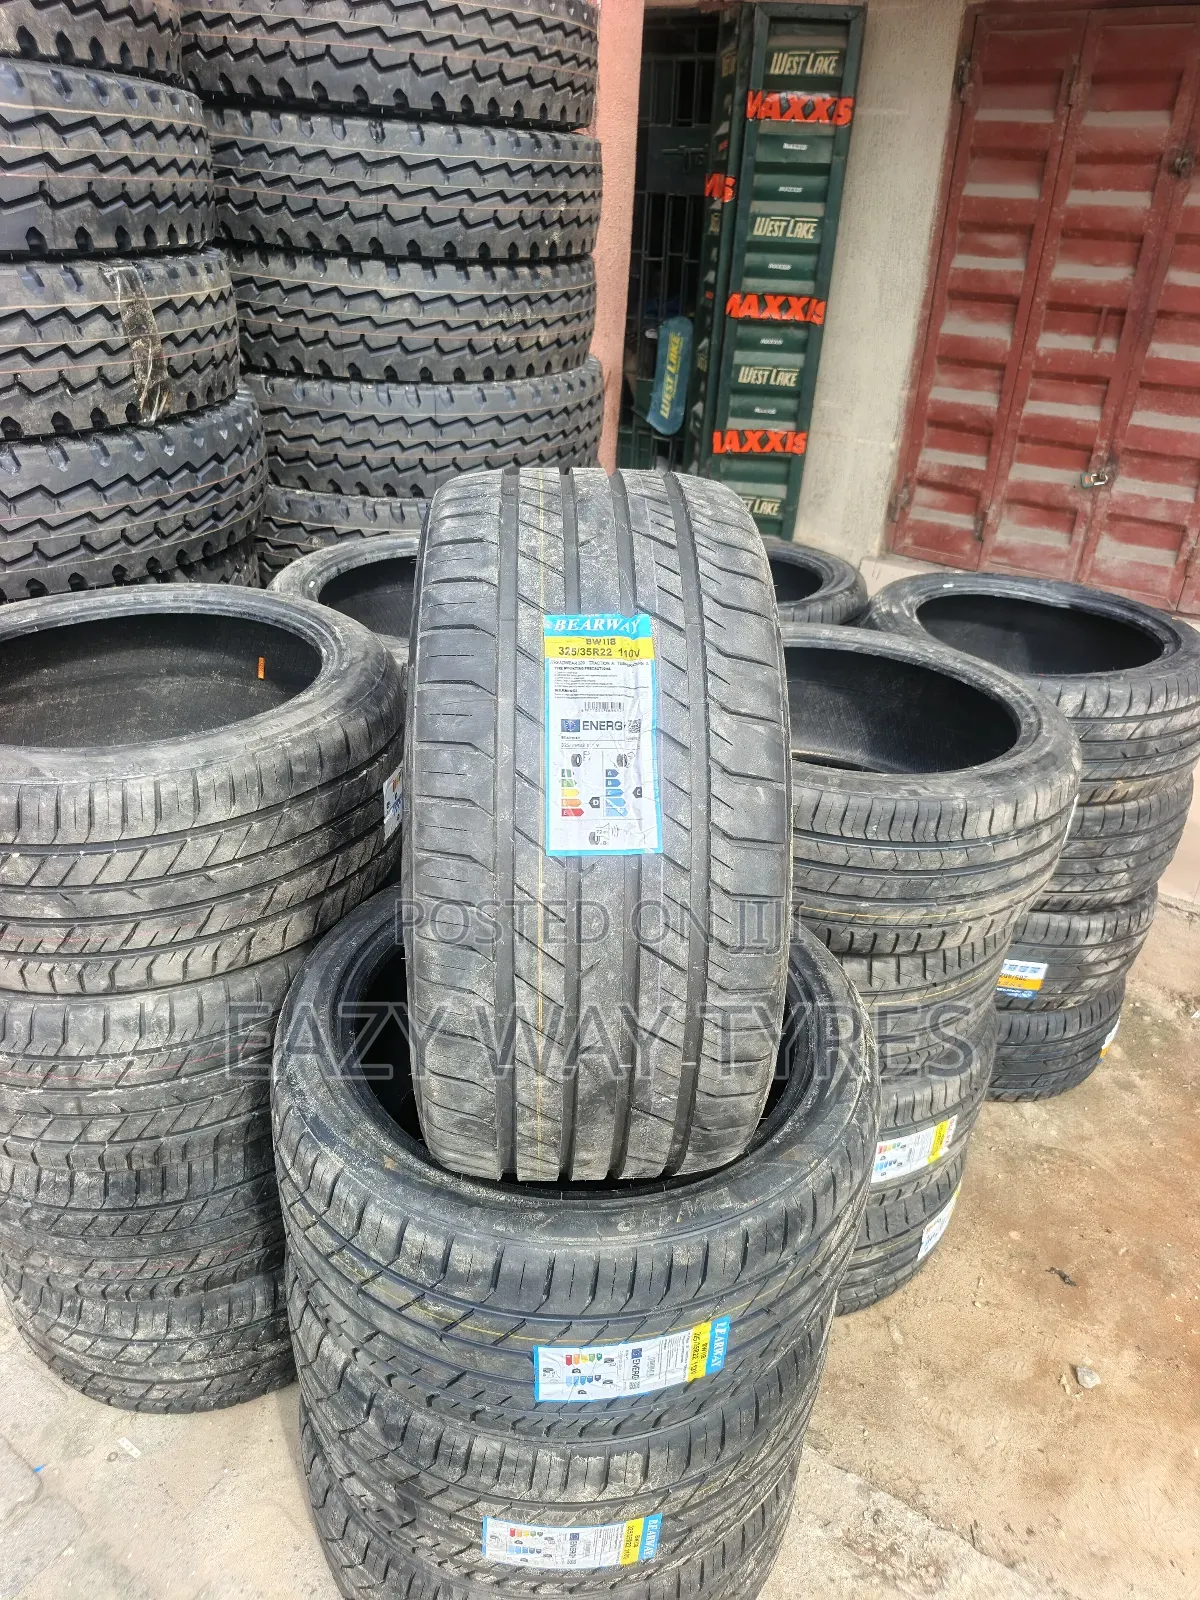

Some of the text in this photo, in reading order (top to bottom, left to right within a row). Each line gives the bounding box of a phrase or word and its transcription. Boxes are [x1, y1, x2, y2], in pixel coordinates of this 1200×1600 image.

[770, 52, 839, 75] WEST LAKE
[753, 217, 818, 239] WEST LAKE
[737, 366, 799, 387] WEST LAKE
[554, 618, 641, 635] BEARWAY
[558, 646, 640, 659] 325/35R22 110V
[582, 721, 623, 731] ENERG
